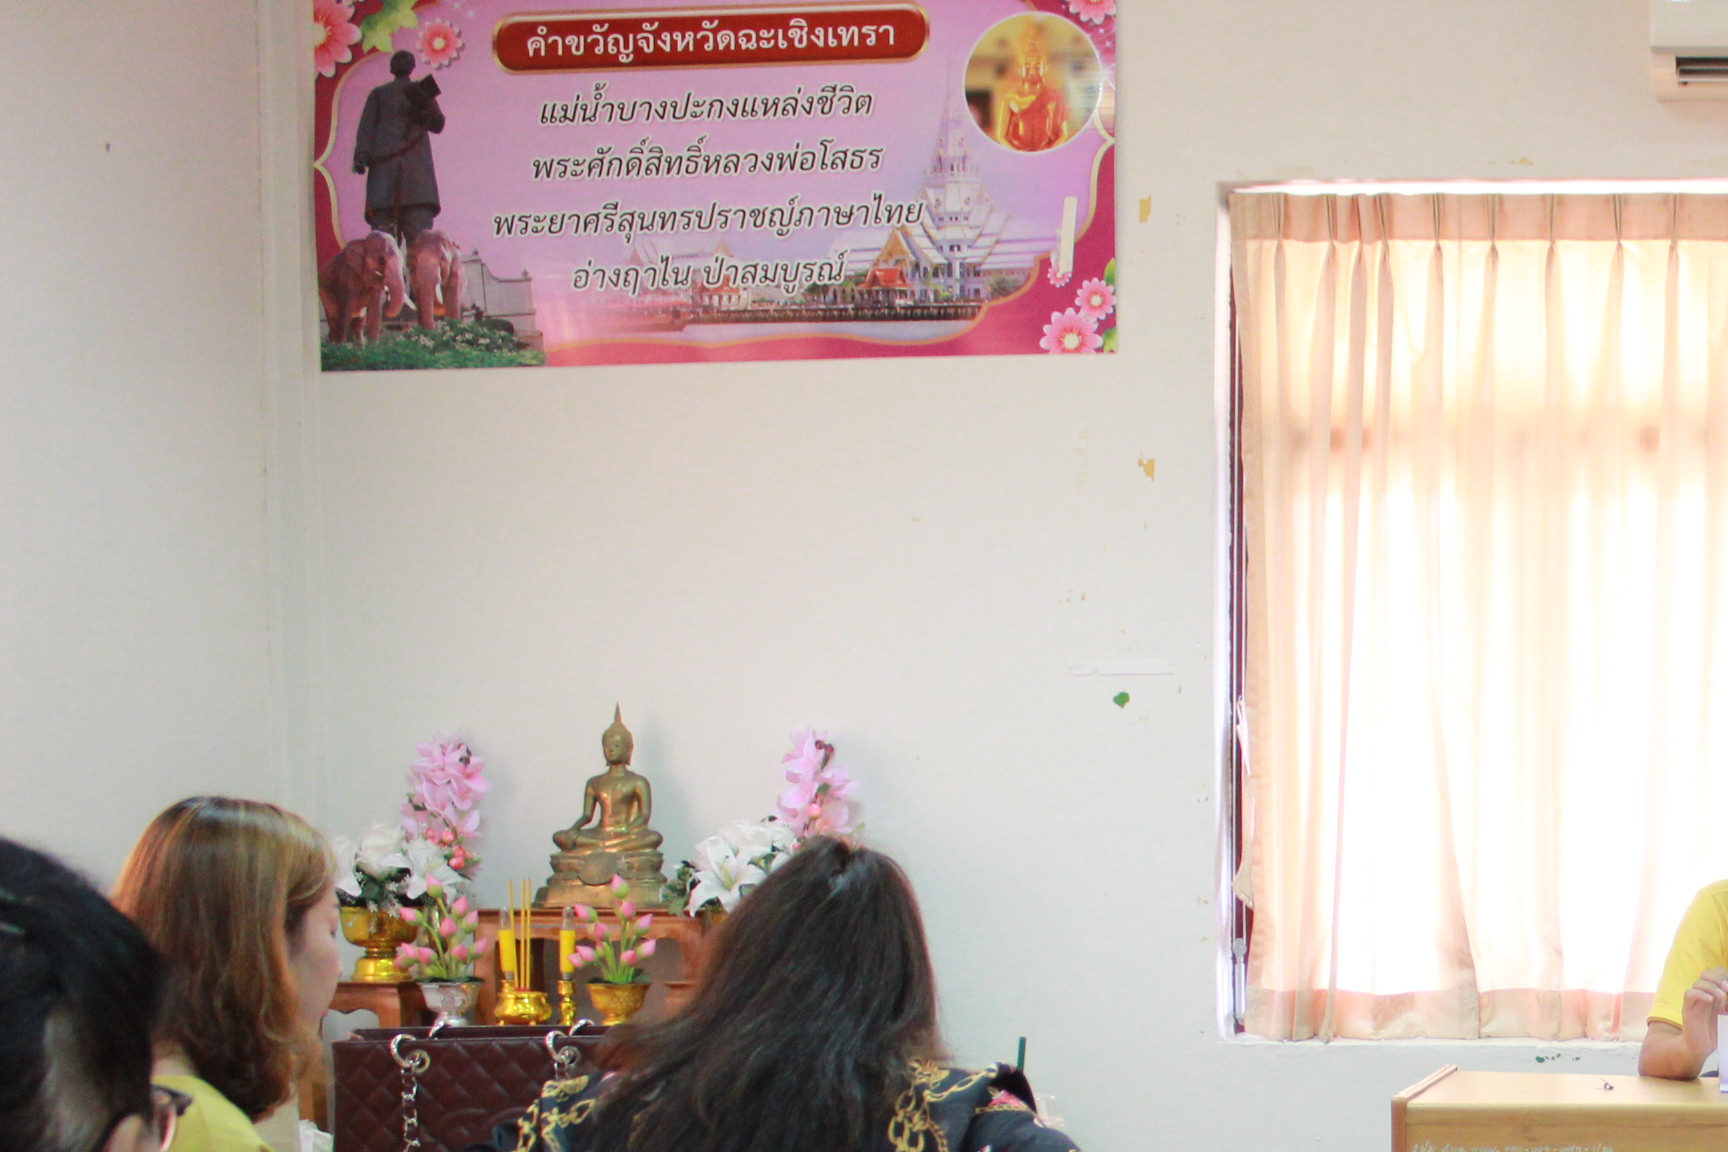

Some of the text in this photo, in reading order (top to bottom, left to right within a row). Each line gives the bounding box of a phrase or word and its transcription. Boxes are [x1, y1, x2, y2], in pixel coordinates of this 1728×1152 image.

[527, 19, 896, 63] คำขวัญจังหวัดฉะเชิงเทรา
[539, 82, 873, 124] แม่น้ำบางปะกงแหล่งชีวิต
[532, 135, 884, 179] พระศักดิ์สิทธิ์หลวงพ่อโสธร
[493, 192, 926, 243] พระยาศรีสุนทรปราชญ์ภาษาไทย
[703, 250, 847, 294] ป่าสมบูรณ์
